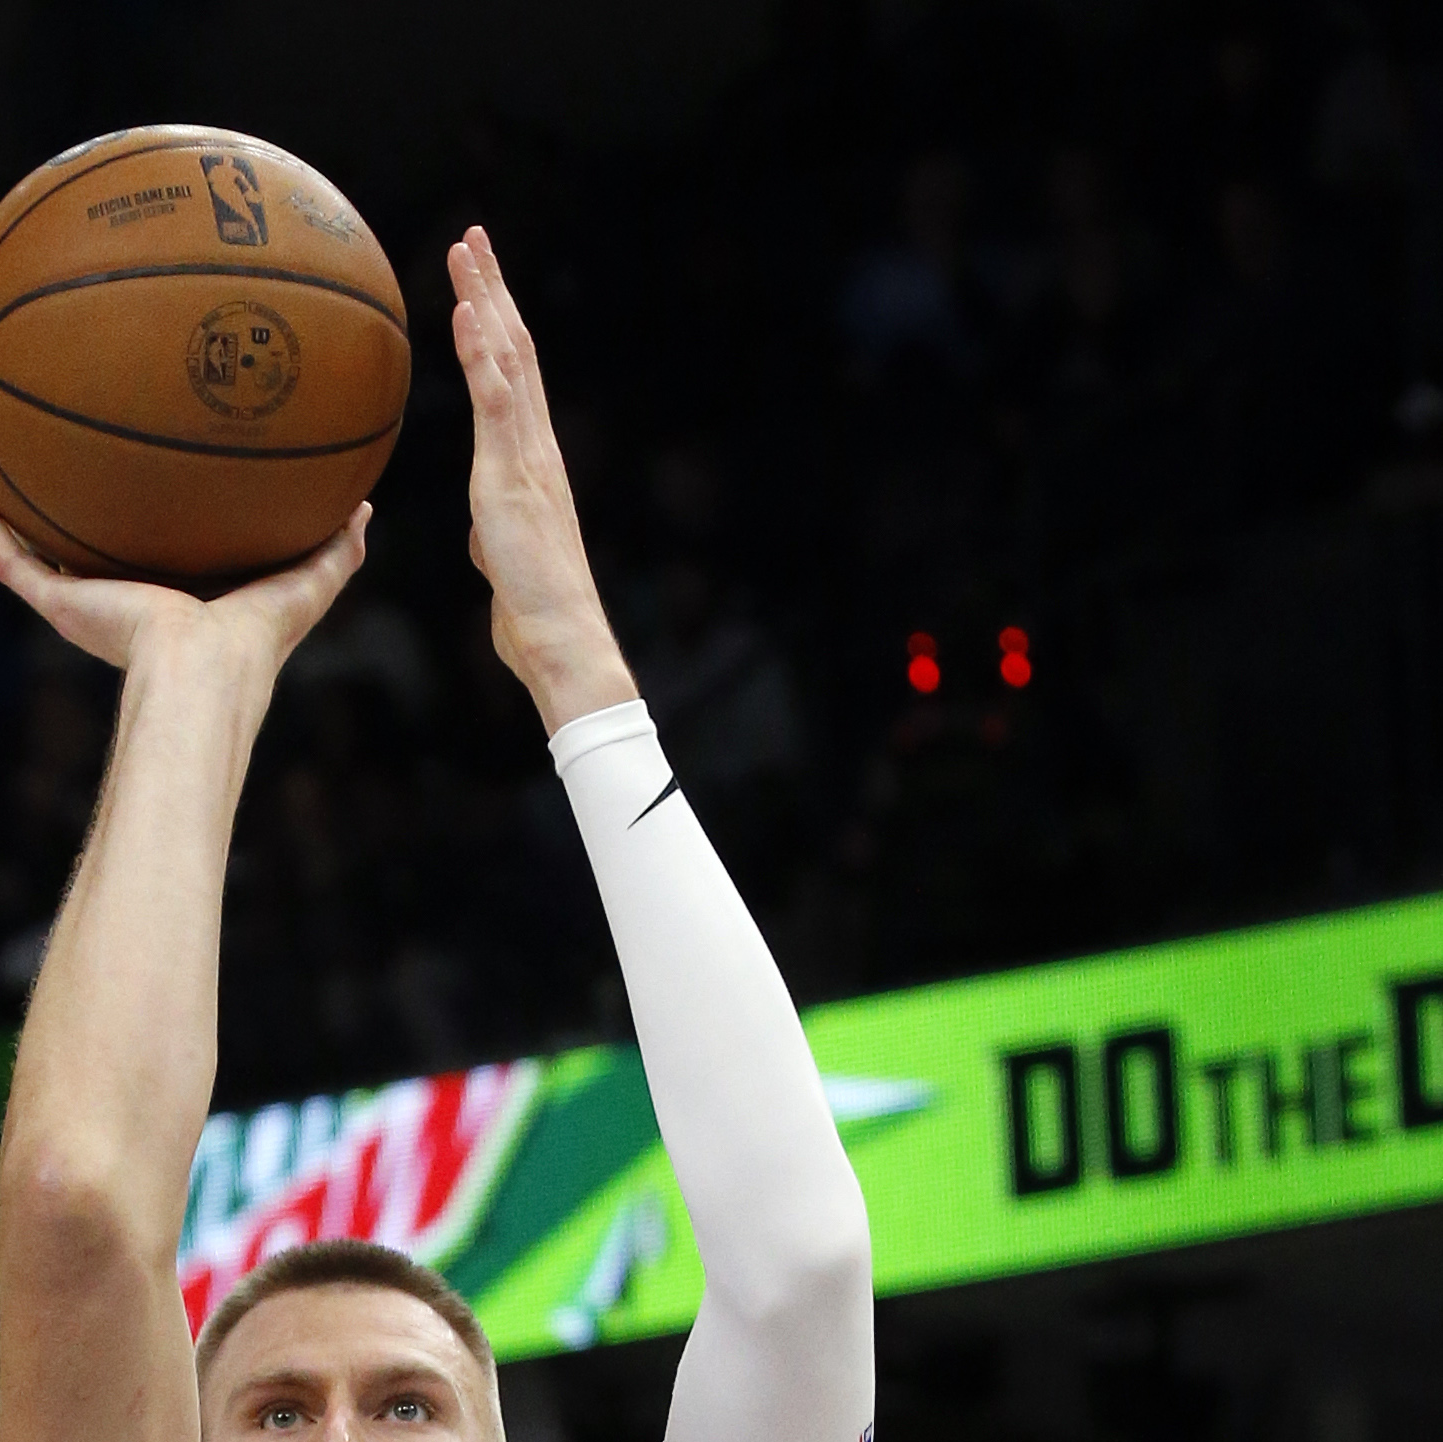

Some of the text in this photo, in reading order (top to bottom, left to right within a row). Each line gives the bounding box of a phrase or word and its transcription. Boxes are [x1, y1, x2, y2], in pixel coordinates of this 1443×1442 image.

[166, 185, 192, 200] BALL
[1005, 1024, 1179, 1196] DO
[1203, 1028, 1376, 1168] THE
